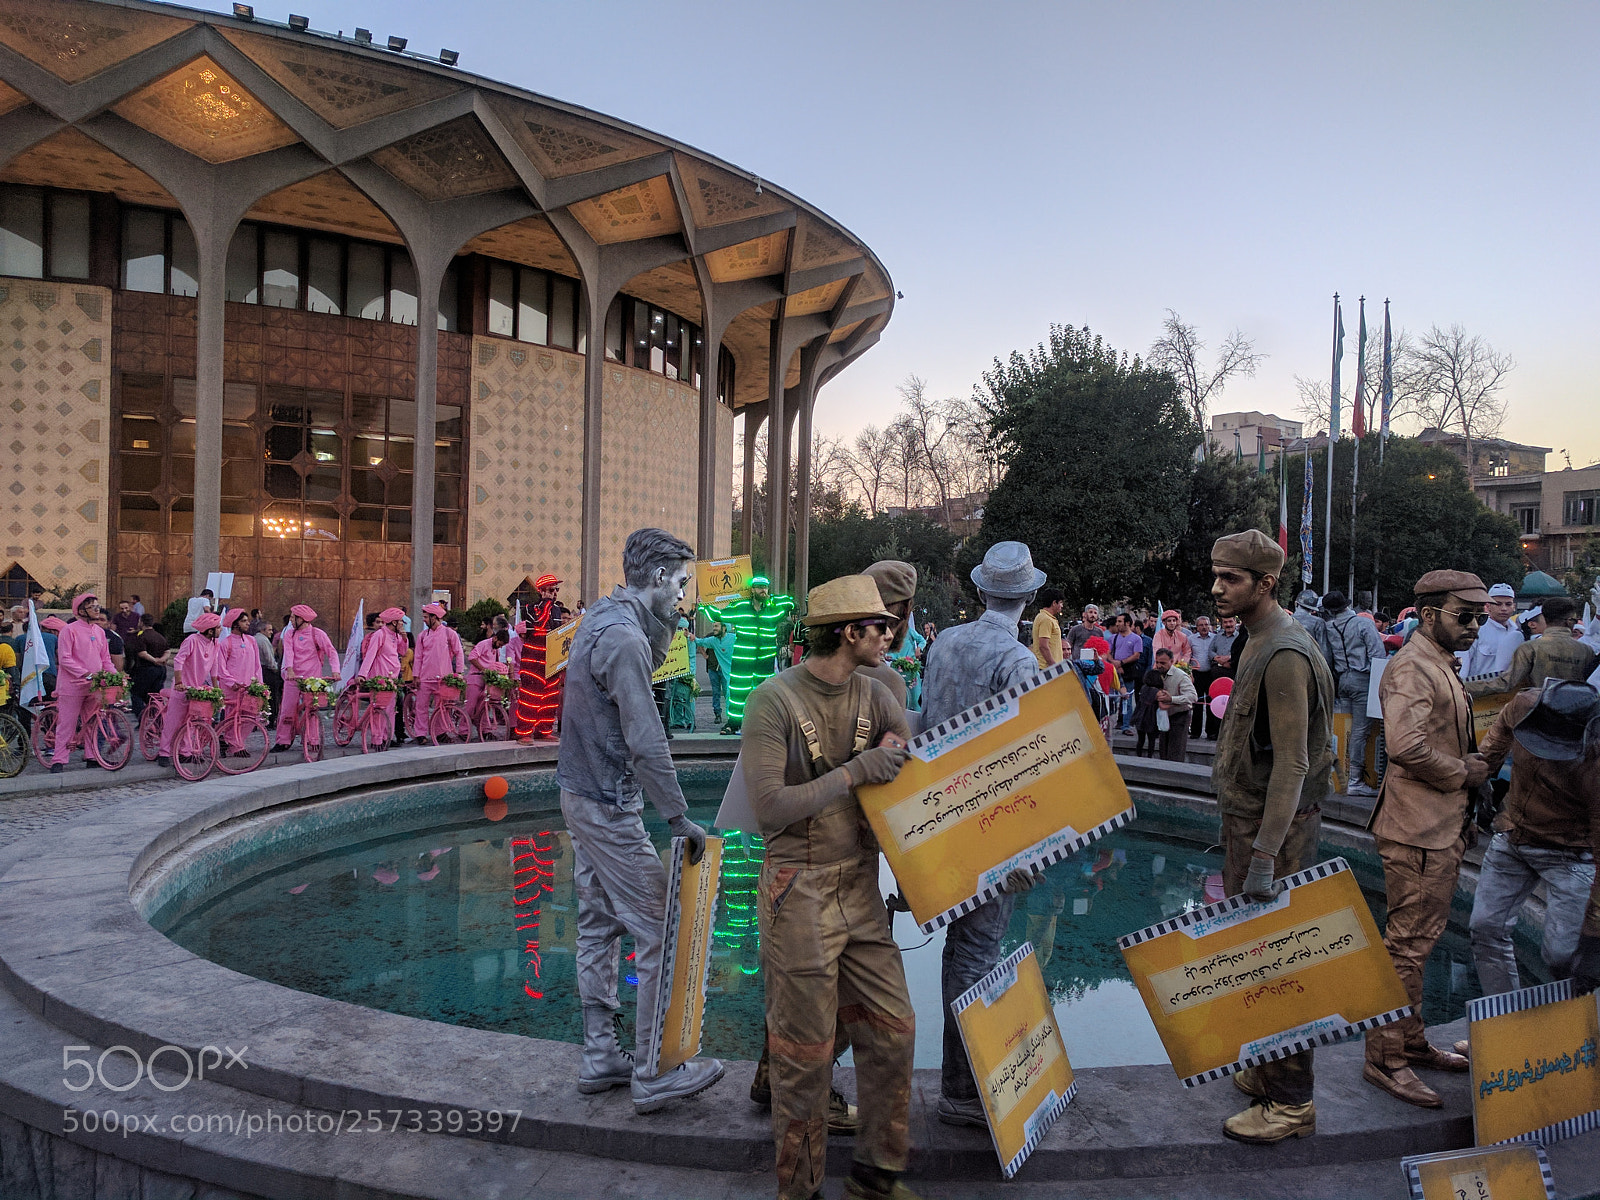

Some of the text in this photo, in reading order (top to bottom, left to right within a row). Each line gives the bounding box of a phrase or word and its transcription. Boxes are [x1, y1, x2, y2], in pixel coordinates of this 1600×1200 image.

[905, 739, 1080, 839] سرعت وسیله نقلیه رابطه مستقیم با میزان
[923, 734, 1046, 805] مرگ عابران در تصادفات دارد
[1170, 993, 1180, 1005] در
[1178, 986, 1213, 1000] صورت
[1214, 975, 1234, 989] بروز
[1235, 966, 1271, 985] تصادف
[1272, 958, 1282, 970] در
[1286, 946, 1311, 964] حریم
[1329, 934, 1353, 949] متری
[1184, 966, 1197, 980] پل
[1200, 959, 1216, 974] عابر
[1250, 941, 1267, 956] عابر
[1266, 931, 1300, 951] مقصر
[1298, 927, 1320, 942] است
